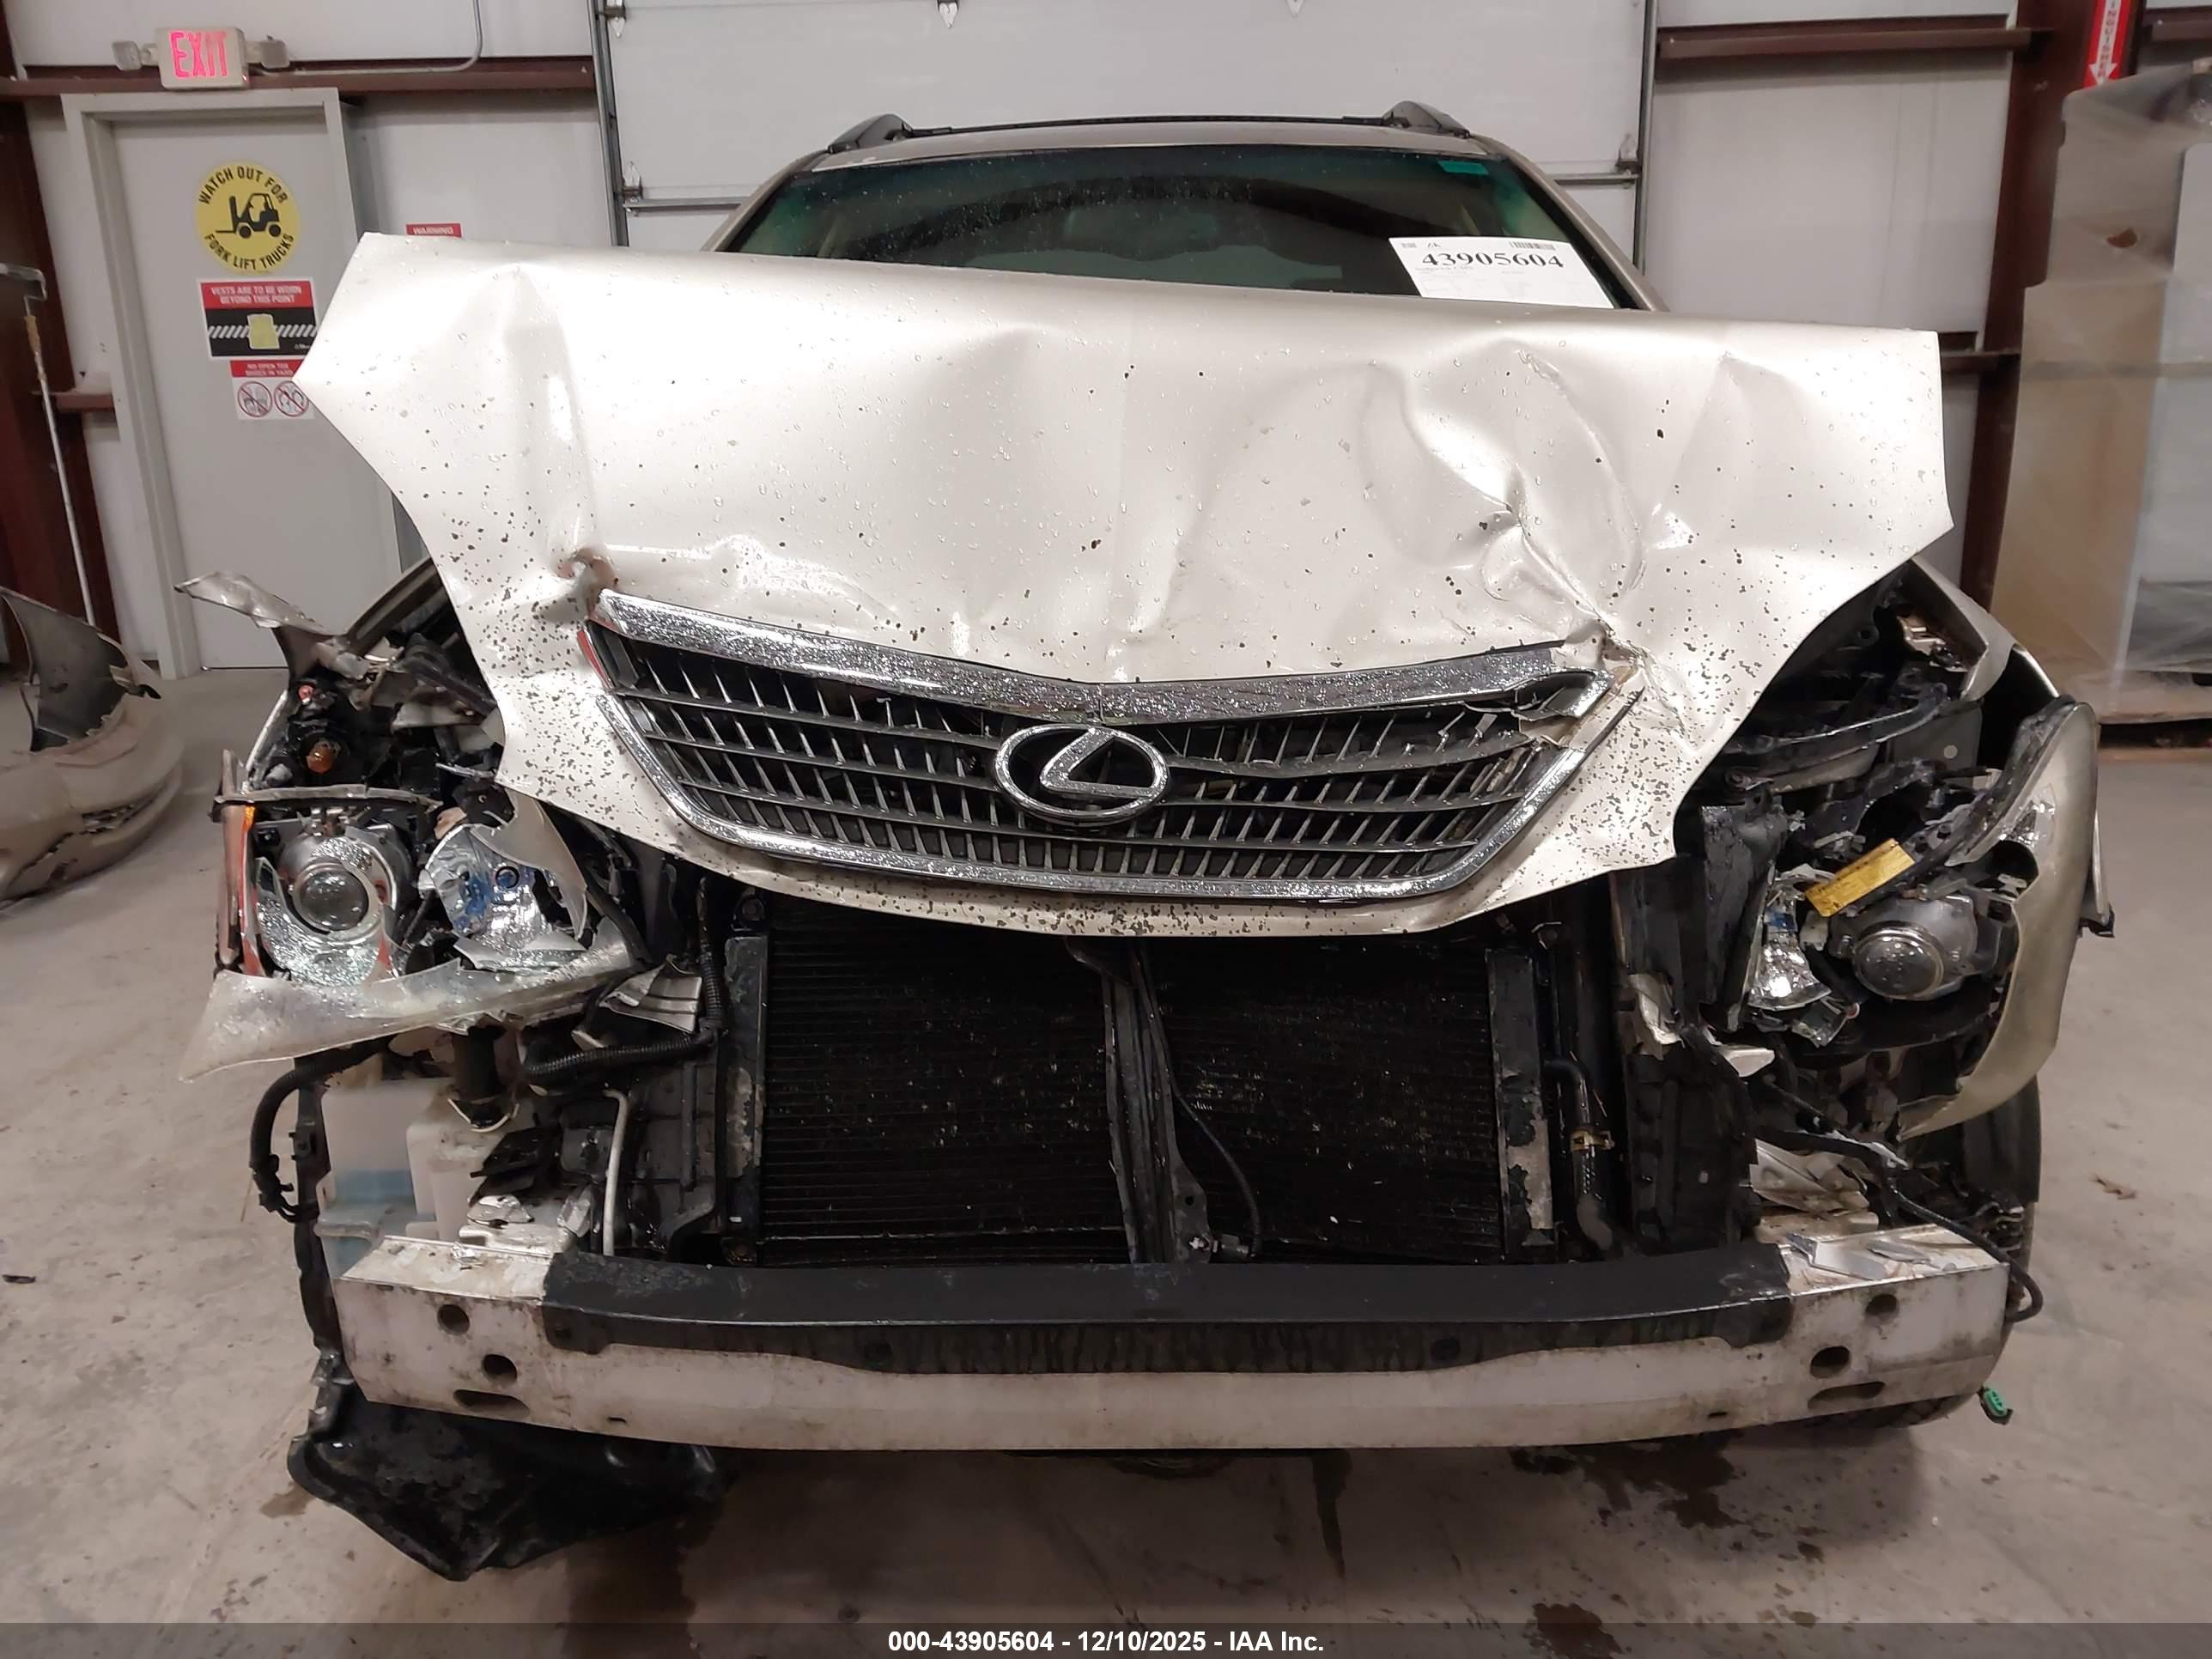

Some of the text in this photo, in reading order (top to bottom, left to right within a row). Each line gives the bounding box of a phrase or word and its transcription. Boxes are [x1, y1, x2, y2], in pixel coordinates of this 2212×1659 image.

[169, 31, 228, 77] EXIT
[198, 166, 288, 204] WATCH OUT FOR
[412, 226, 454, 234] WARNING
[204, 233, 294, 270] FORK LIFT TRUCKS
[1422, 252, 1565, 268] 43905604
[210, 287, 235, 295] VESTS
